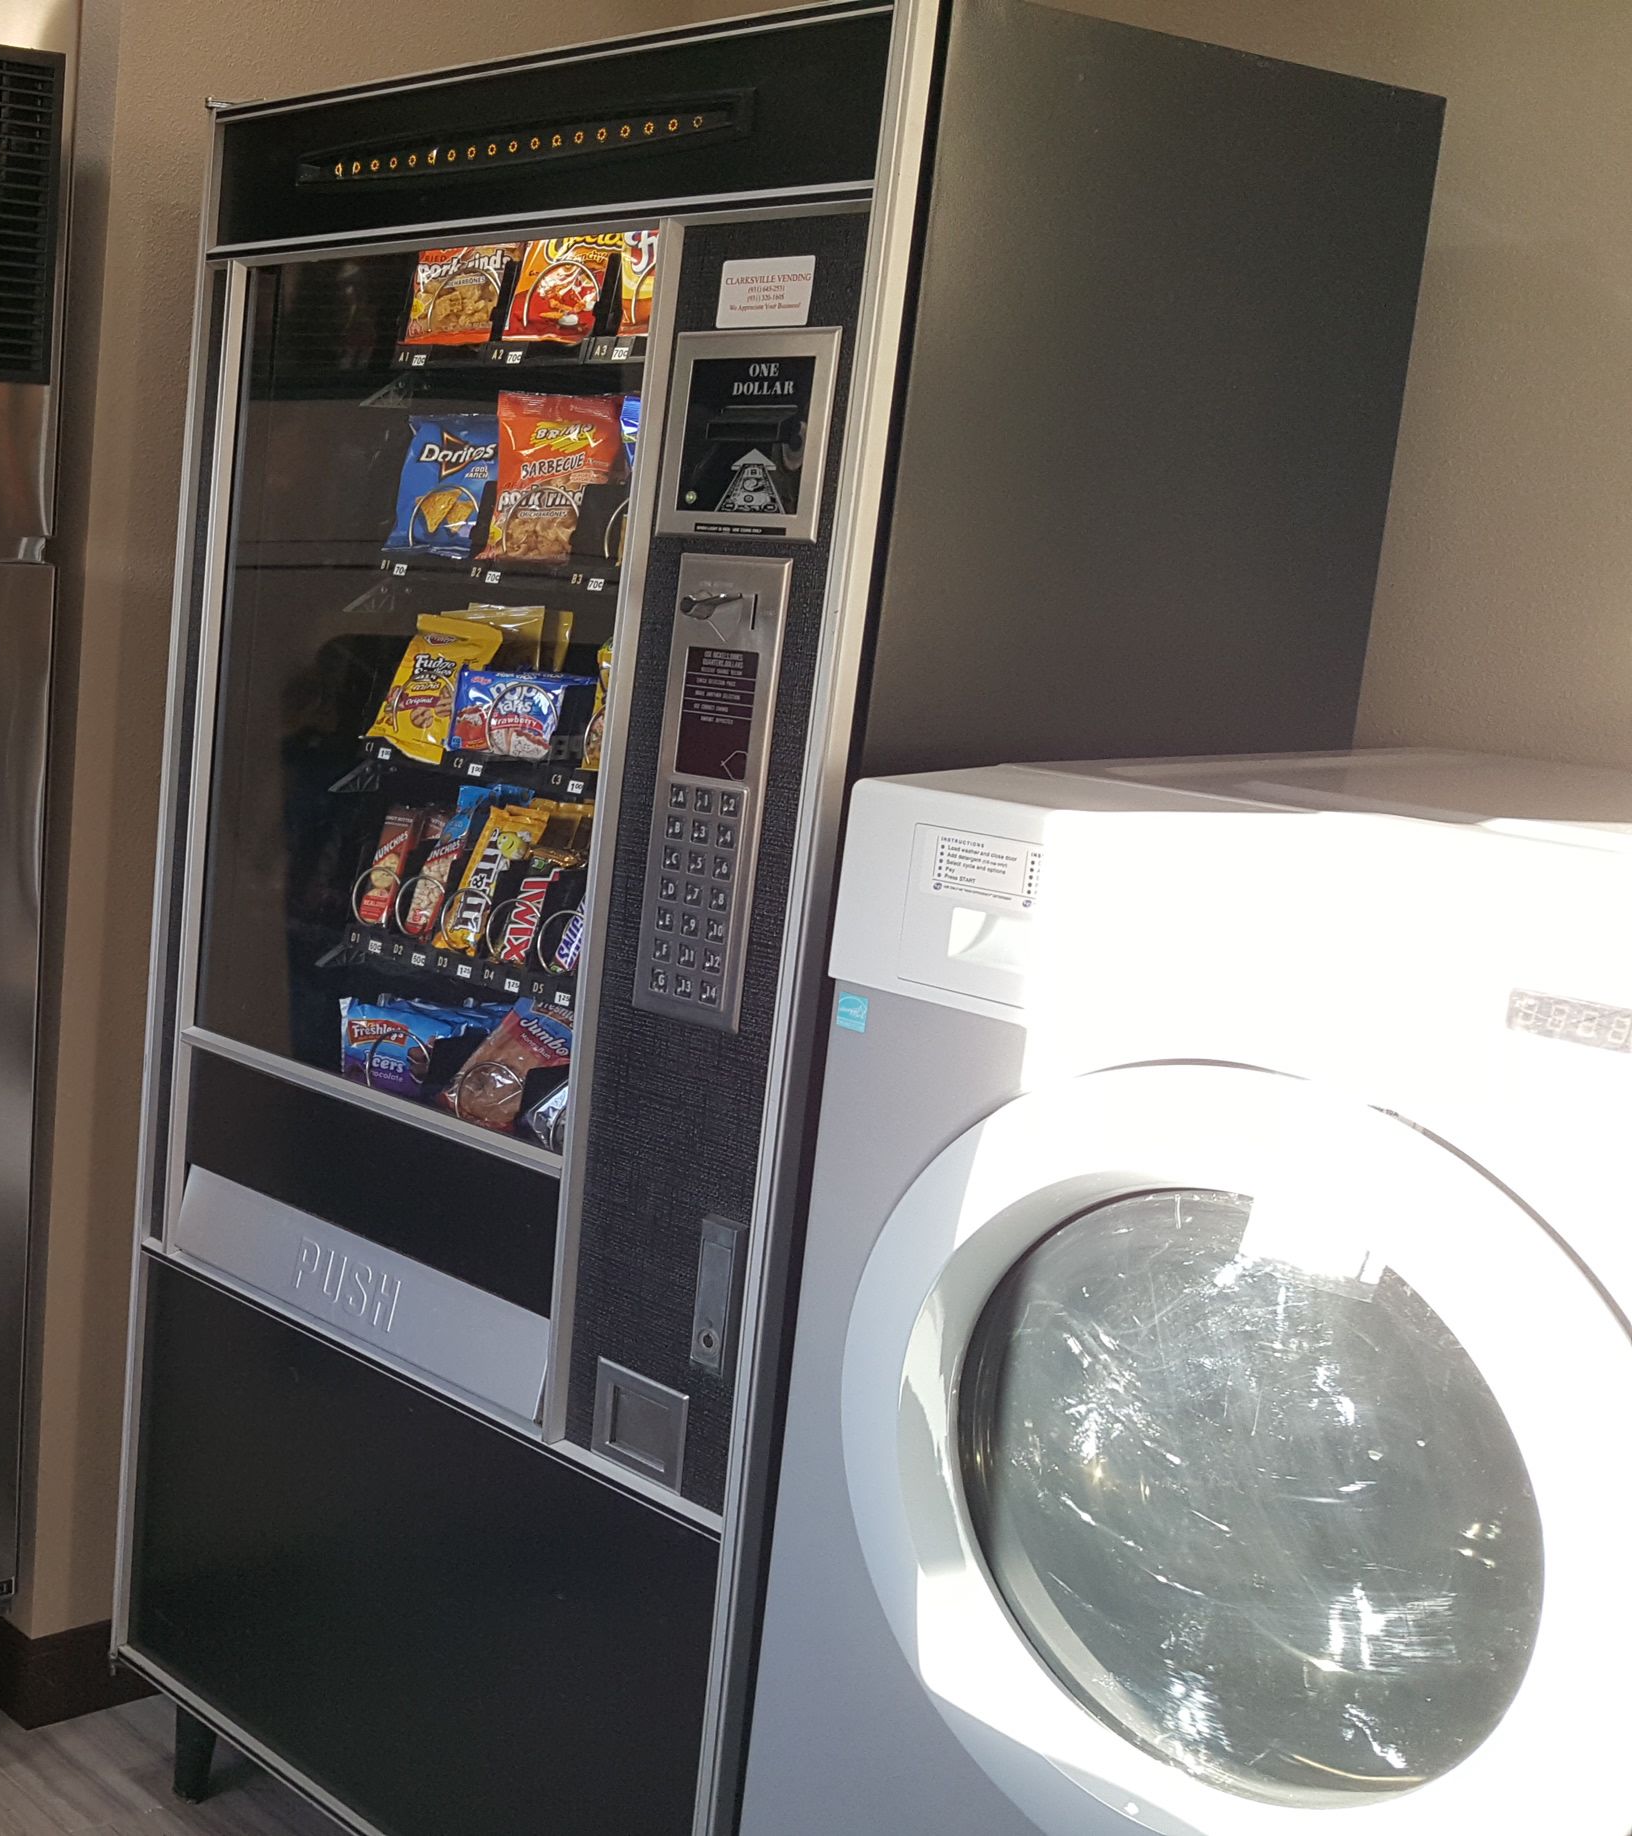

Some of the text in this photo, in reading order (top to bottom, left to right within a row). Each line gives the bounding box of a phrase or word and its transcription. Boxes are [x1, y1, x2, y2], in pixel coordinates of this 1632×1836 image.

[417, 257, 461, 283] pork
[726, 273, 811, 285] CLARKSVILLE VENDING
[595, 345, 628, 359] A3 70¢
[749, 363, 780, 377] ONE
[732, 381, 794, 395] DOLLAR
[420, 443, 497, 464] Doritos
[521, 452, 586, 480] BARBECUE
[588, 581, 603, 589] 70¢
[415, 655, 456, 669] Fudge
[405, 697, 433, 706] Original
[677, 791, 684, 802] A
[729, 799, 735, 811] 2
[674, 822, 731, 842] B 3 4
[941, 837, 984, 848] INSTRUCTIONS
[672, 853, 728, 873] C 5 6
[668, 883, 724, 905] D 7 8
[501, 868, 564, 961] TWIX
[665, 914, 723, 936] E 9 10
[393, 944, 404, 955] D2
[662, 944, 720, 968] F 11 12
[437, 957, 448, 967] D3
[484, 969, 494, 980] D4
[533, 982, 544, 993] D5
[658, 974, 716, 998] G 13 14
[520, 1019, 569, 1056] Jumbo
[291, 1236, 401, 1333] PUSH
